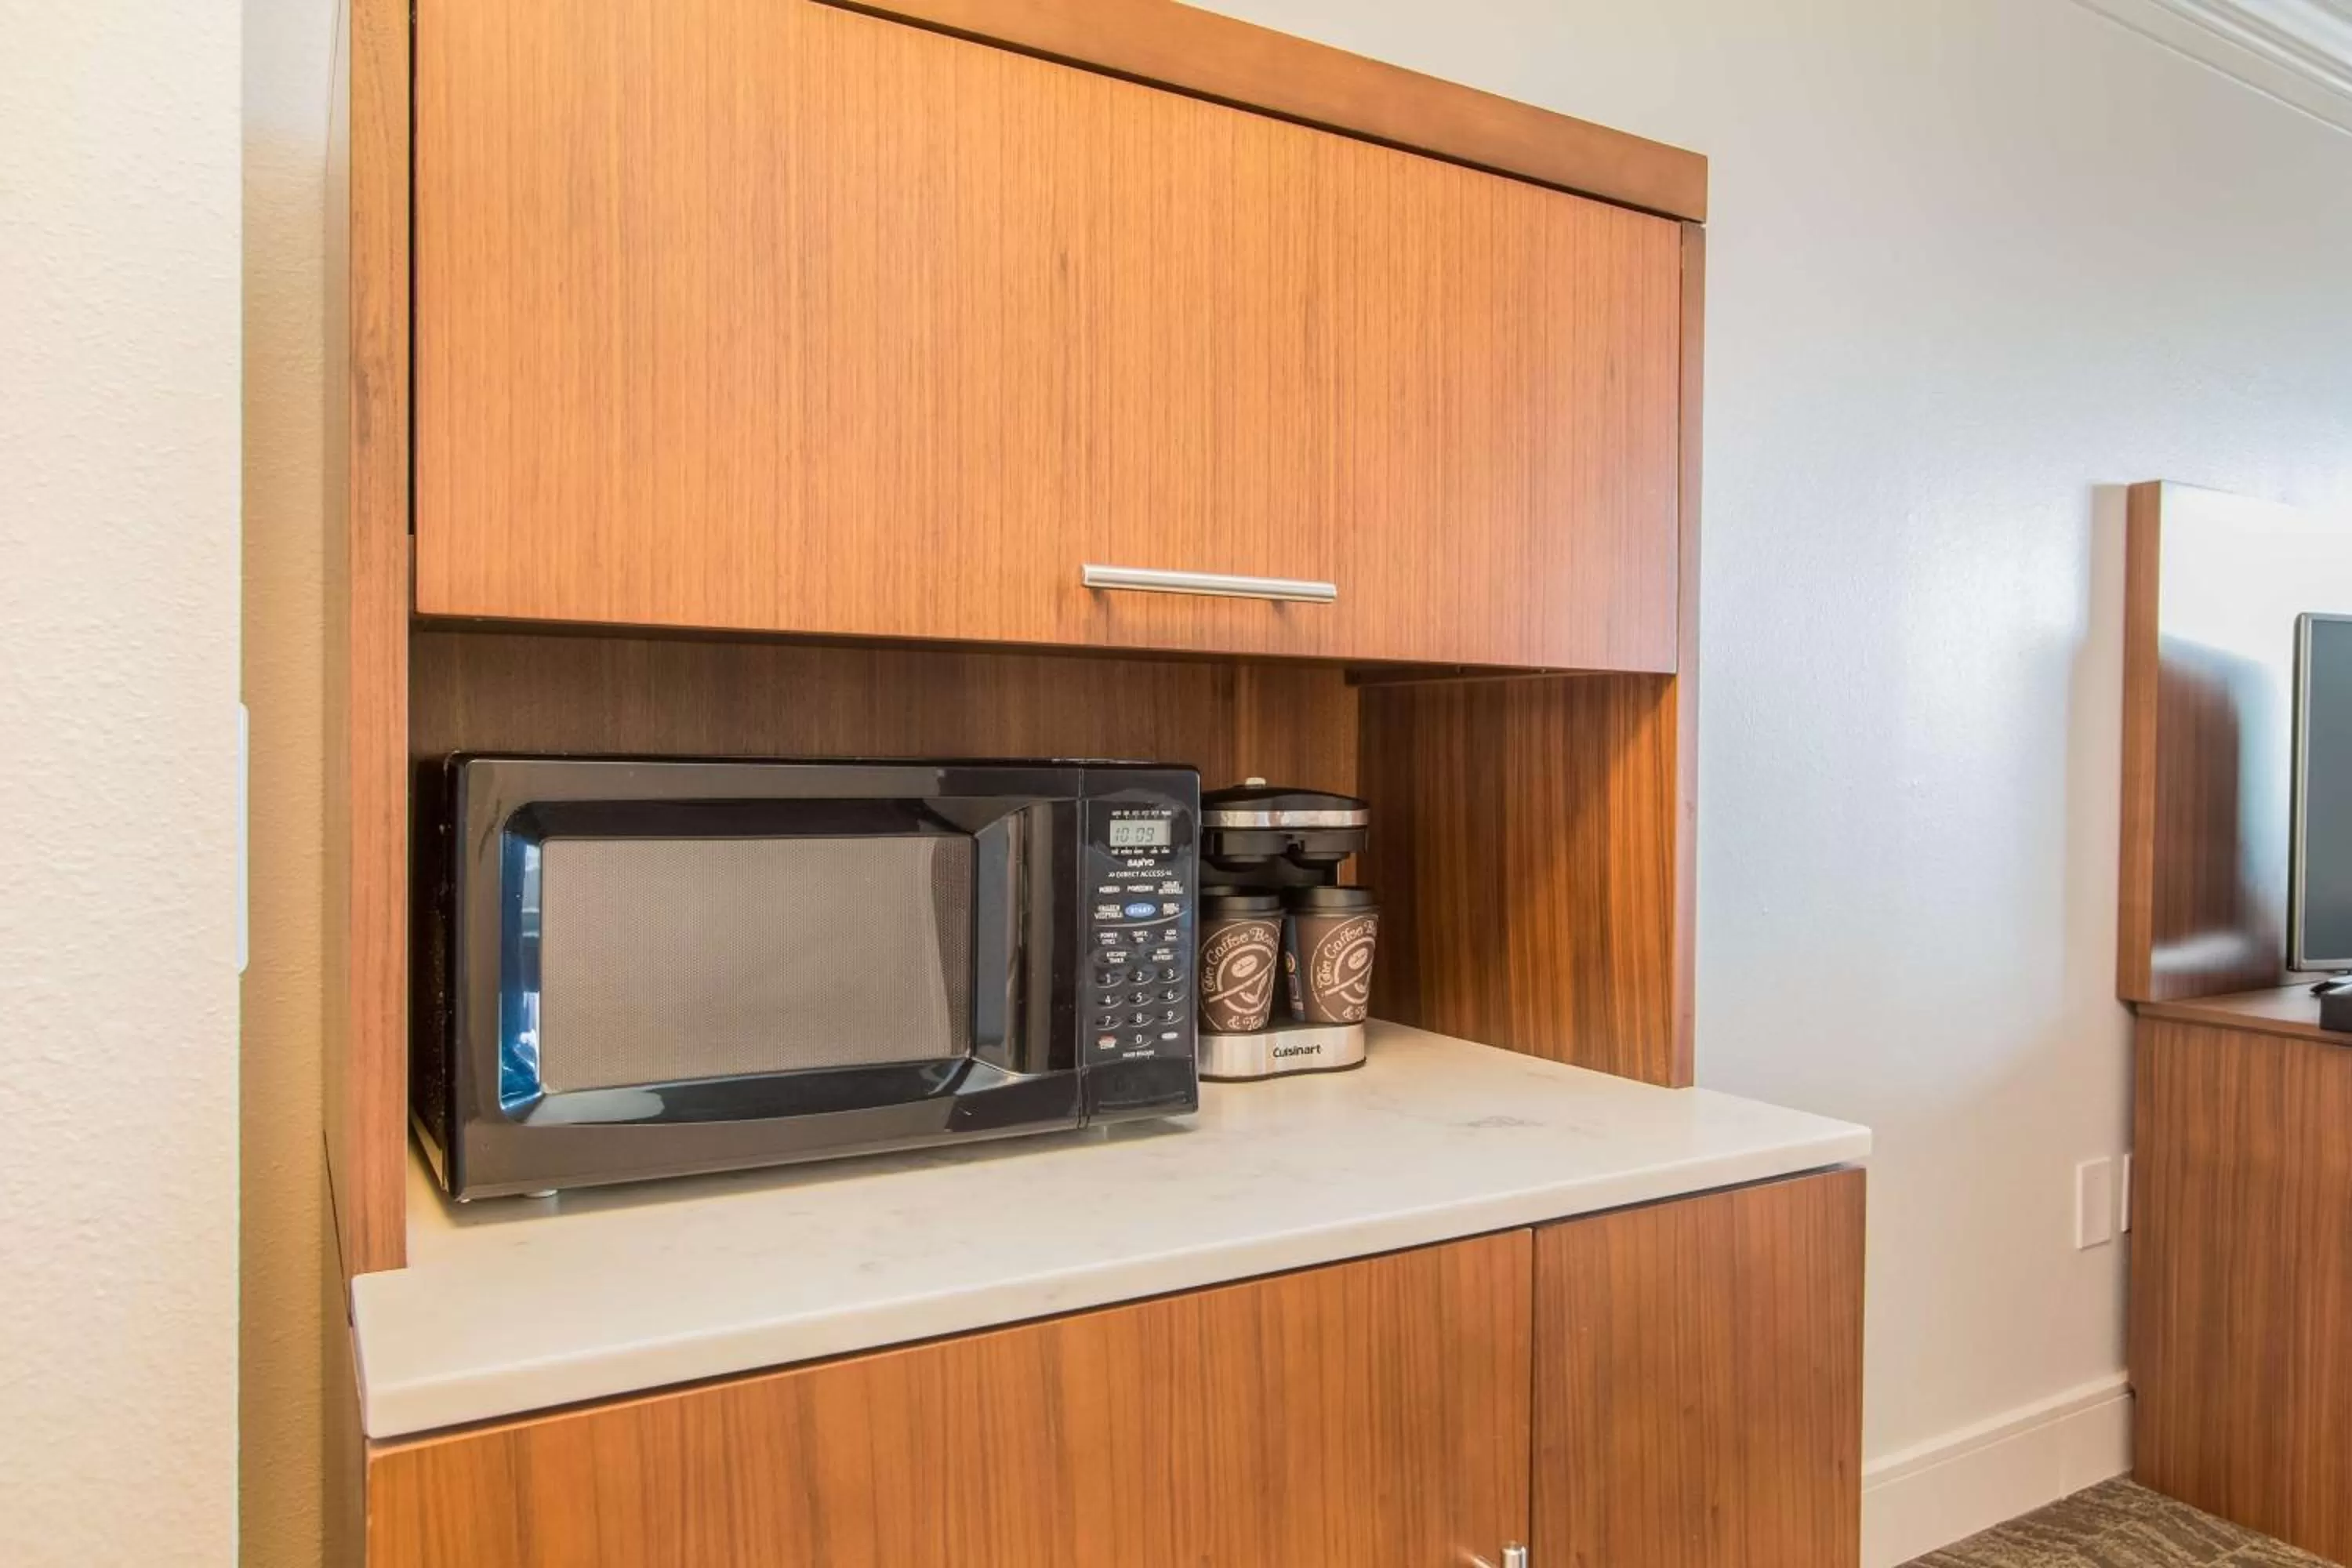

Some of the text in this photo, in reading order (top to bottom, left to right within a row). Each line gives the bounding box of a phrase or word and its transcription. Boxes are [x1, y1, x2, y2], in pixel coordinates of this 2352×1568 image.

[1324, 927, 1363, 959] Coffee
[1206, 933, 1249, 965] Coffee
[1105, 973, 1110, 983] 1
[1136, 971, 1142, 981] 2
[1167, 968, 1174, 978] 3
[1105, 995, 1111, 1004] 4
[1136, 992, 1142, 1003] 5
[1167, 989, 1174, 1000] 6
[1105, 1015, 1111, 1025] 7
[1136, 1012, 1142, 1023] 8
[1167, 1011, 1174, 1020] 9
[1136, 1034, 1142, 1044] 0
[1272, 1044, 1321, 1058] Cuisinart
